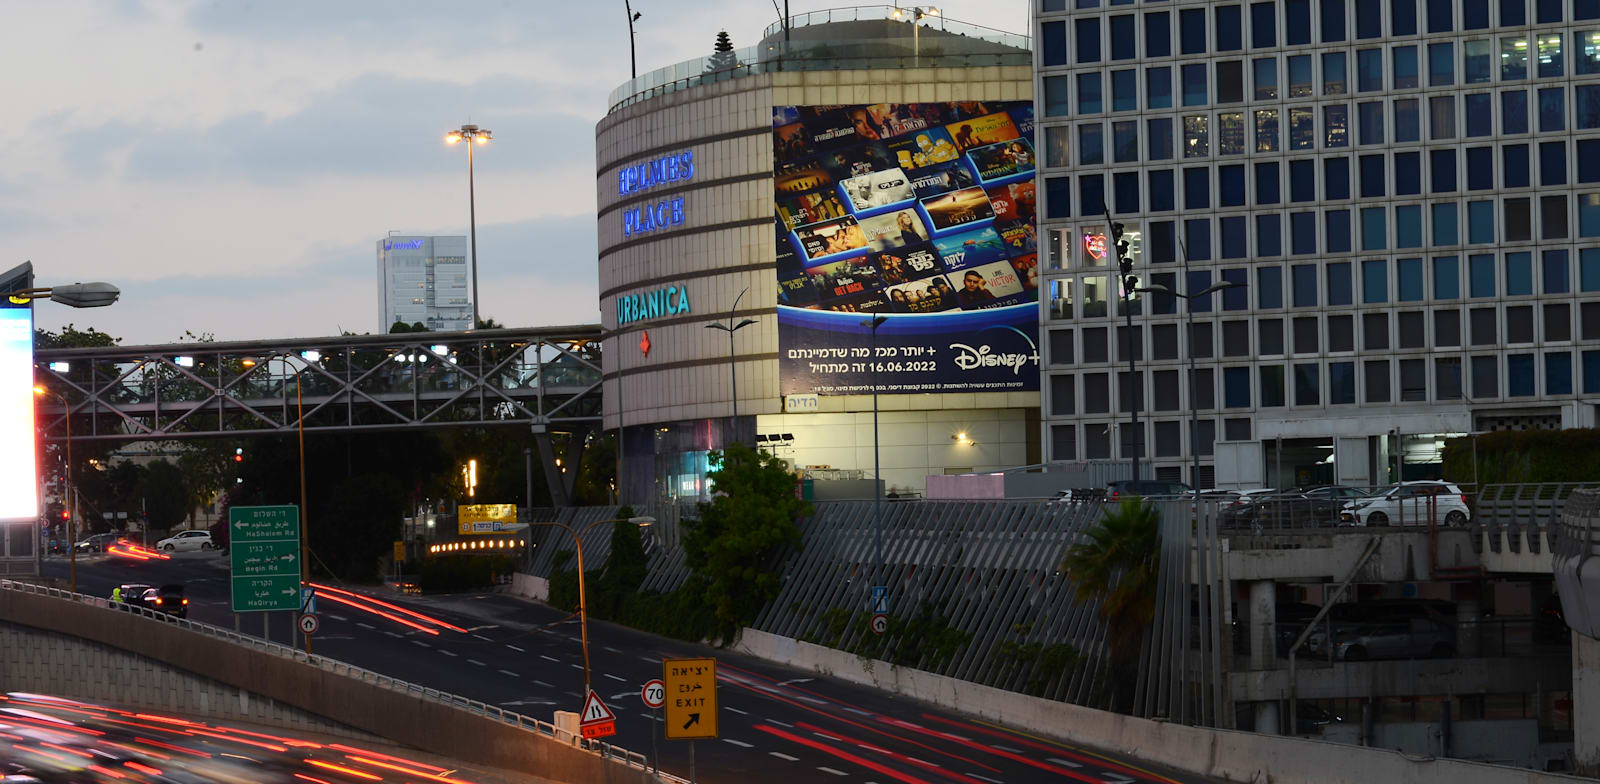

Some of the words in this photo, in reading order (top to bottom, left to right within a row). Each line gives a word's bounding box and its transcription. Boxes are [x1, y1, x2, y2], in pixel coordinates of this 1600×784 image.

[618, 150, 695, 196] HOLMES
[624, 196, 685, 237] PLACE
[1013, 239, 1023, 247] 4
[988, 275, 1016, 287] VICTOR
[833, 286, 847, 296] GET
[846, 282, 865, 293] BACK
[616, 285, 691, 325] URBANICA
[788, 348, 848, 359] שדמיינתם
[851, 347, 870, 358] מה
[900, 347, 924, 357] יותר
[809, 361, 849, 374] מתחיל
[852, 363, 866, 373] זה
[869, 360, 937, 373] 16.06.2022
[788, 397, 817, 408] הדיה
[245, 565, 266, 573] Begin
[248, 599, 278, 607] HaQirya
[672, 667, 709, 676] יציאה
[648, 688, 664, 700] 70
[679, 684, 703, 693] خروج
[676, 698, 705, 707] EXIT
